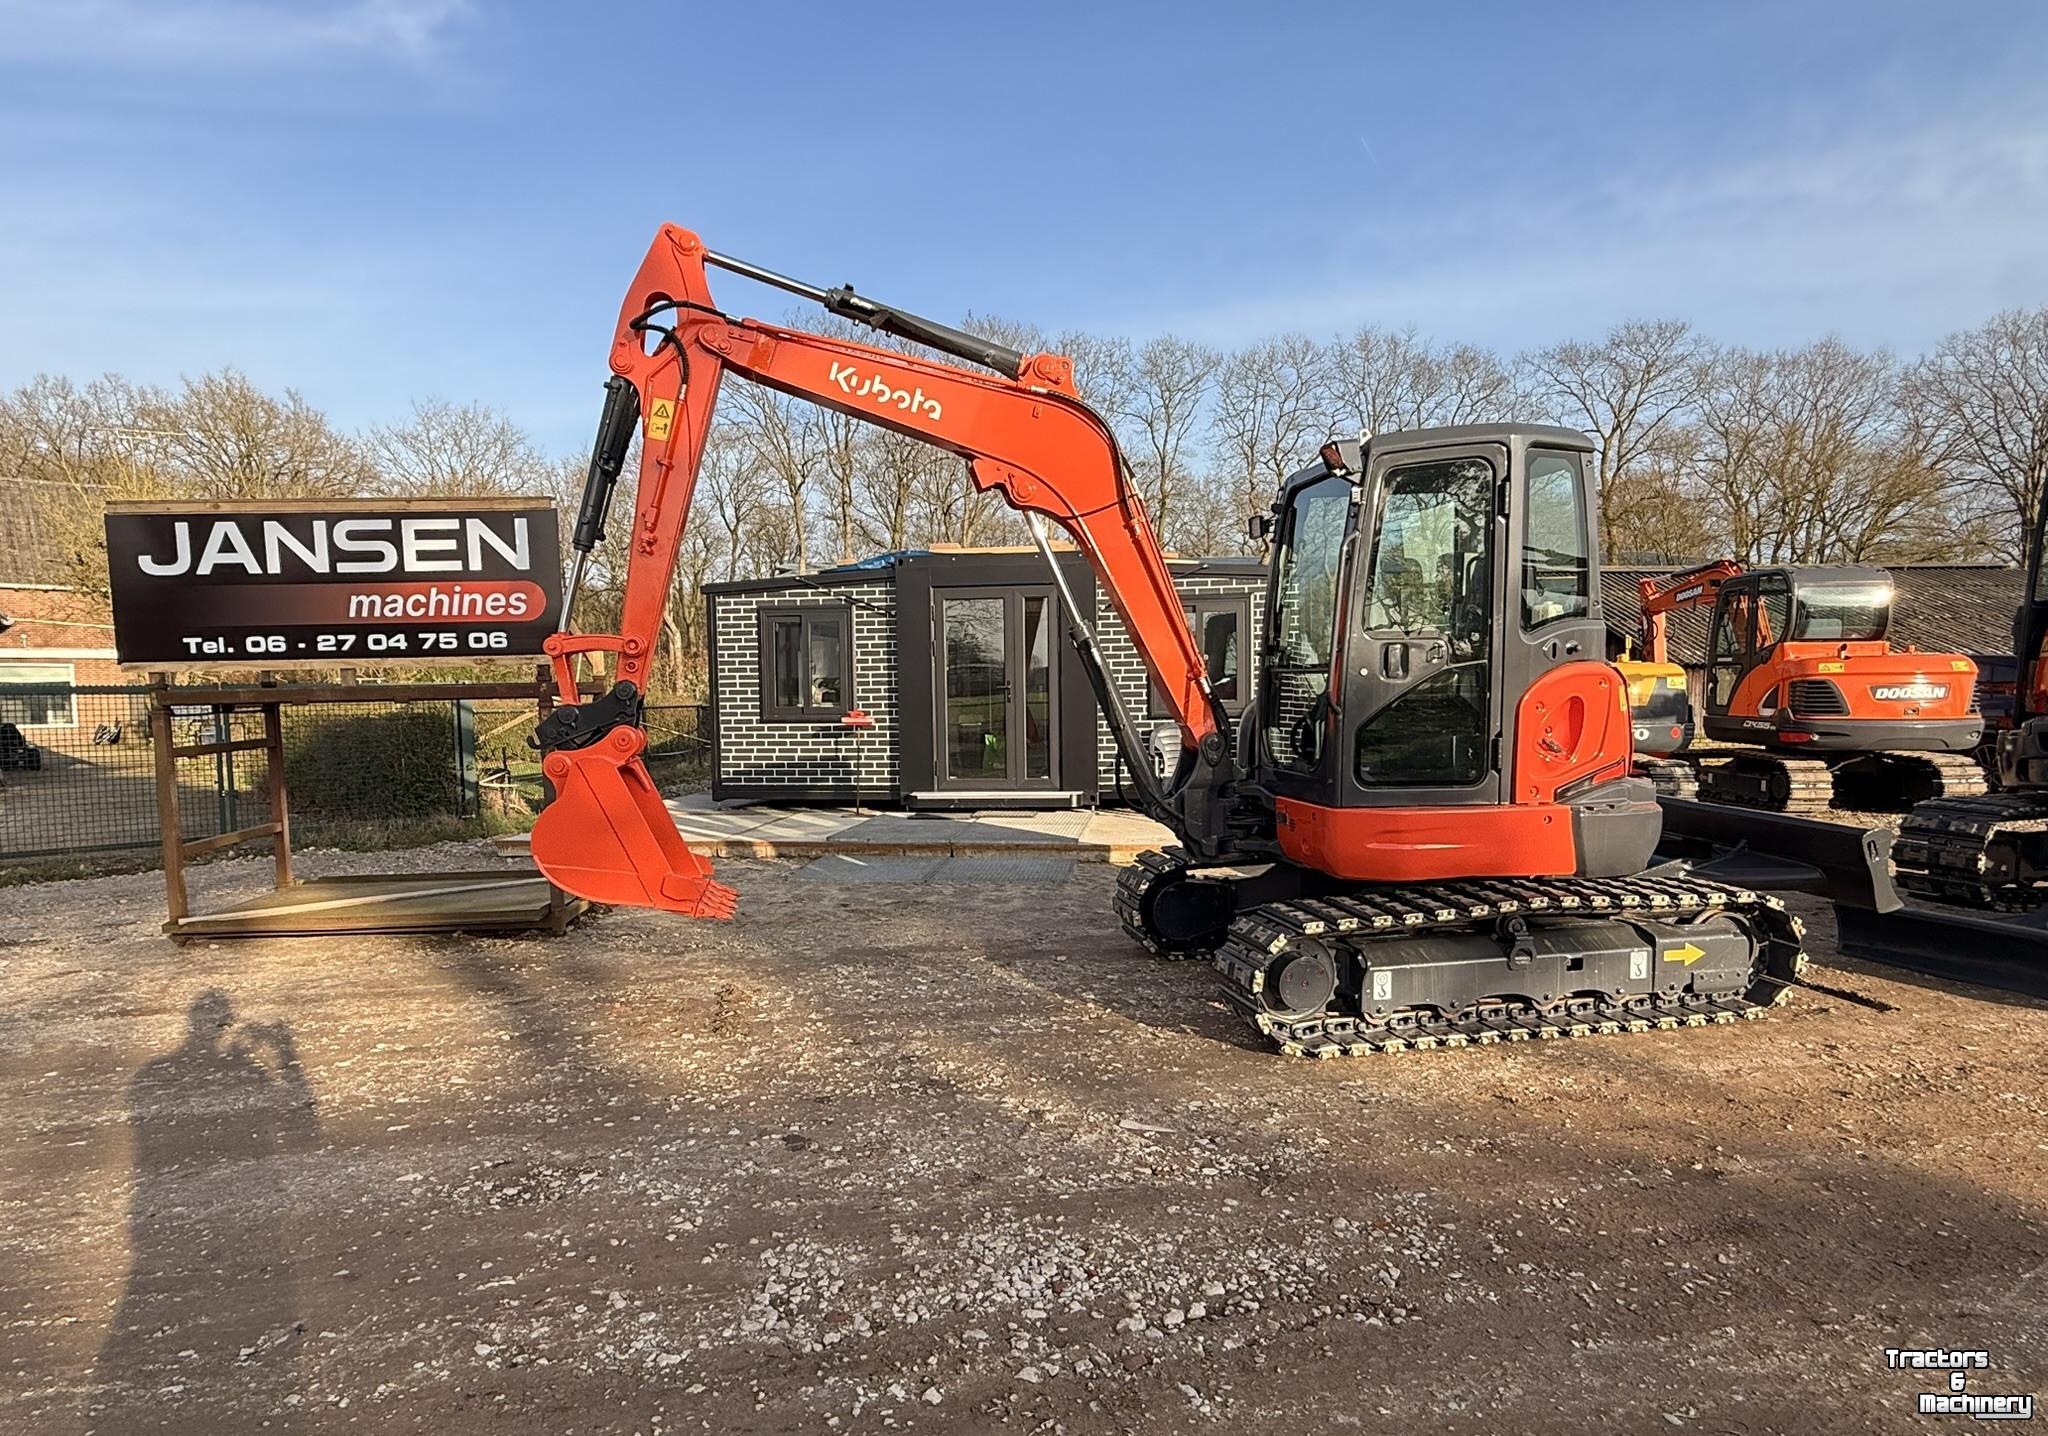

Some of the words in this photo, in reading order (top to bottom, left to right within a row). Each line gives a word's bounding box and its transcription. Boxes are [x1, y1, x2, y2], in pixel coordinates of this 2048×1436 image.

[829, 361, 942, 421] Kubota
[137, 518, 531, 577] JANSEN
[348, 585, 529, 619] machines
[182, 635, 235, 655] Tel.
[245, 635, 287, 653] 06
[316, 634, 357, 652] 27
[367, 633, 408, 651] 04
[418, 632, 458, 650] 75
[468, 631, 508, 649] 06
[1874, 686, 1947, 699] DOOSAN
